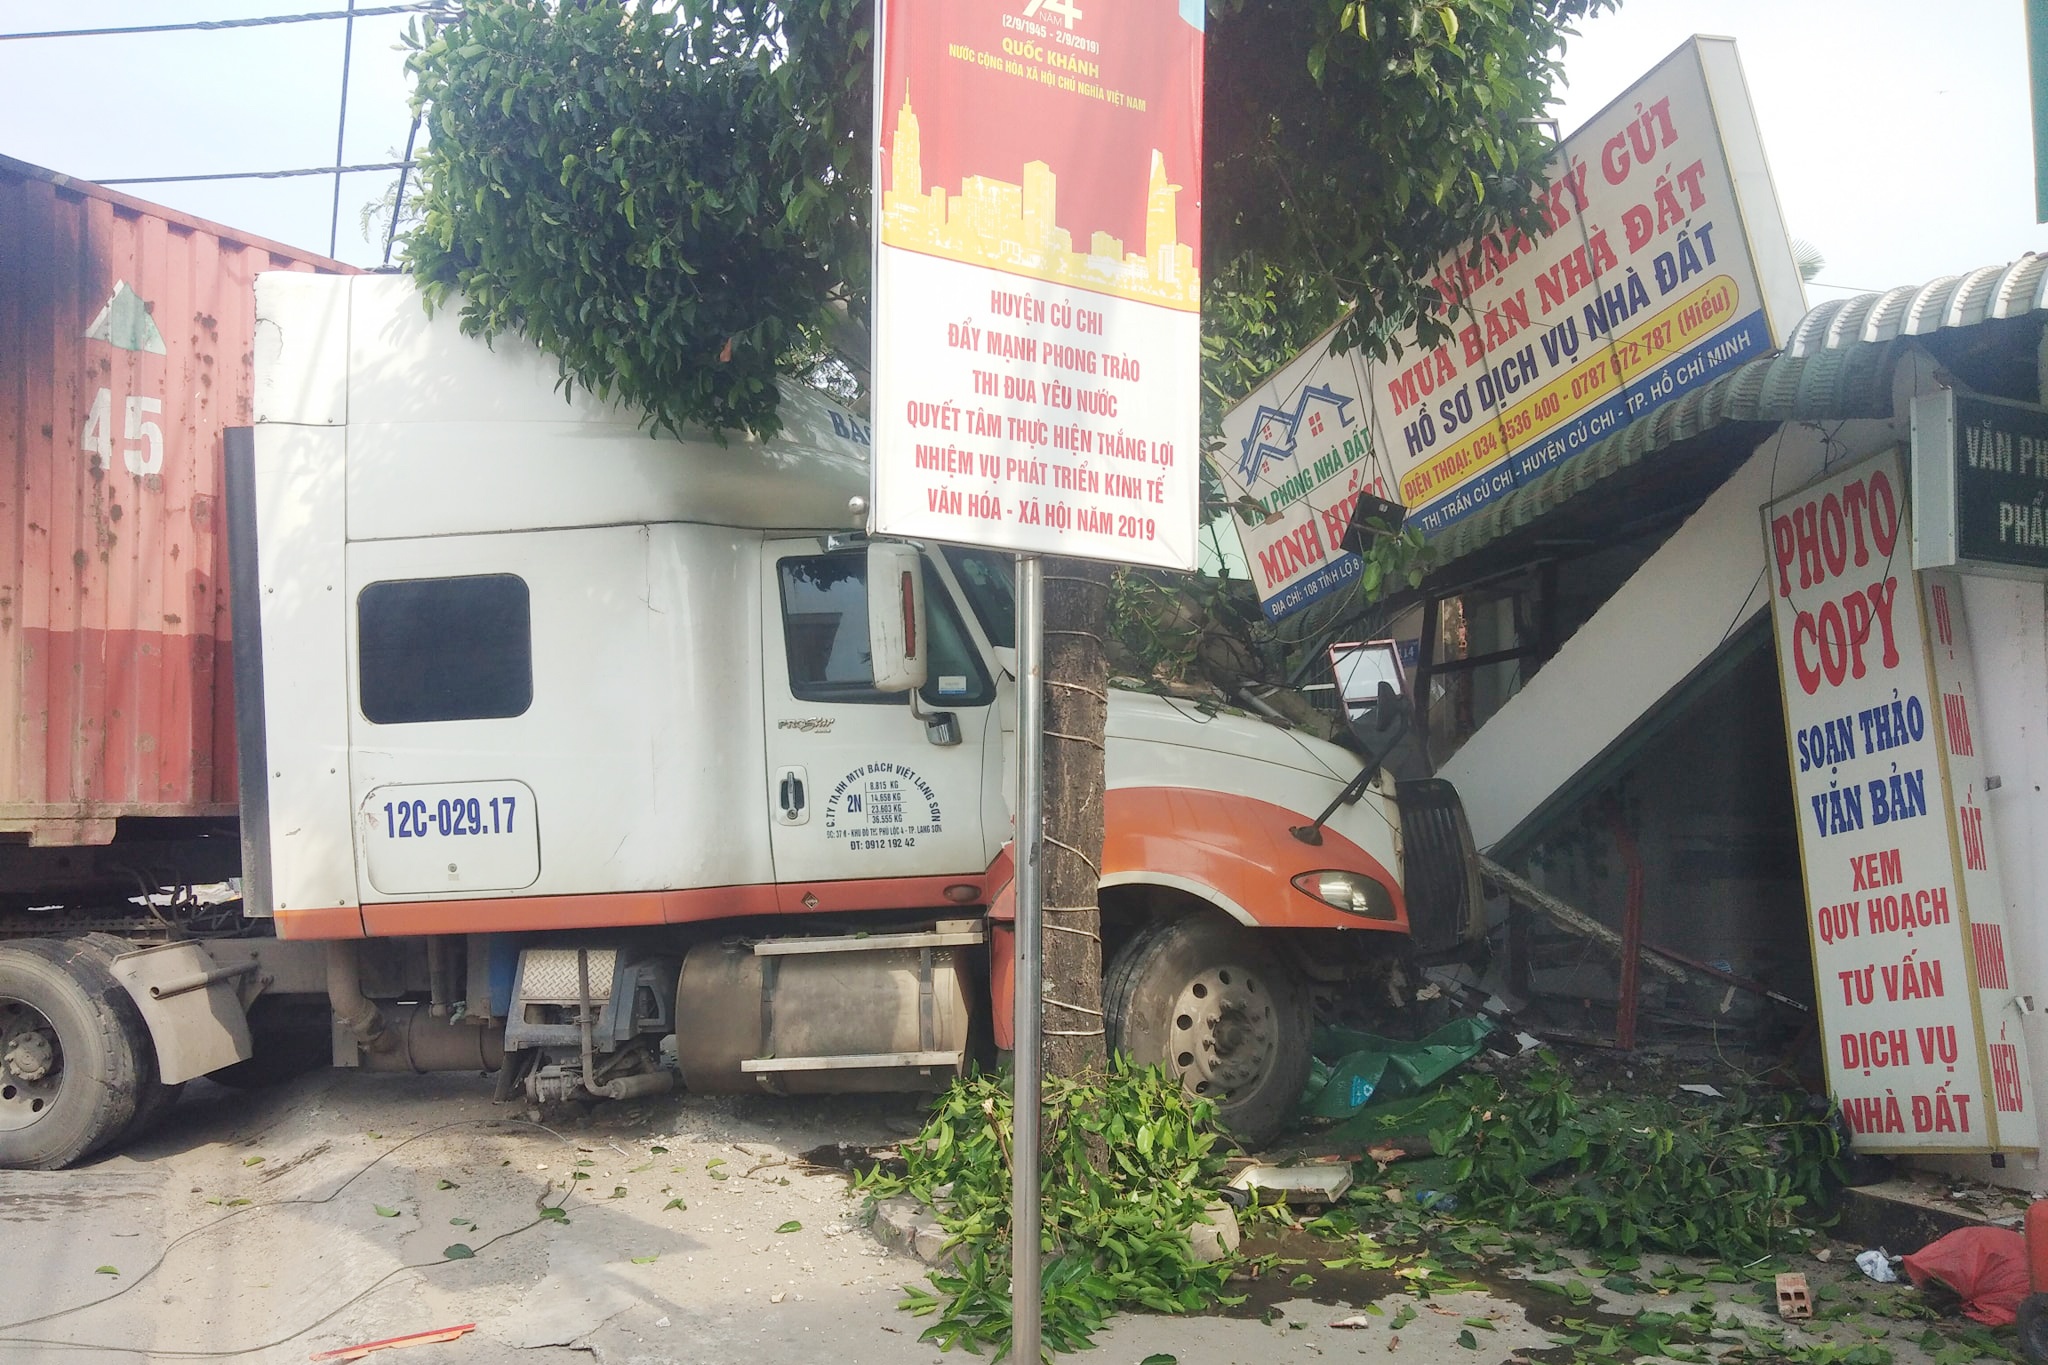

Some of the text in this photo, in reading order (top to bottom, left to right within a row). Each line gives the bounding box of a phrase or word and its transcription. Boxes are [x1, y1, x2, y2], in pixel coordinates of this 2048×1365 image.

[1002, 13, 1047, 38] (2/9/1945
[1055, 30, 1100, 55] 2/9/2019)
[1002, 36, 1099, 79] QUỐC KHÁNH
[948, 43, 975, 63] NƯỚC
[977, 51, 1003, 71] CỘNG
[1005, 59, 1023, 77] HÒA
[1040, 70, 1056, 88] HỘI
[1058, 75, 1075, 92] CHỦ
[1077, 83, 1104, 101] NGHĨA
[1106, 89, 1124, 108] VIỆT
[1126, 95, 1146, 112] NAM
[1536, 154, 1590, 239] KÝ
[1601, 95, 1679, 185] GỬI
[990, 289, 1103, 336] HUYỆN CỦ CHI
[1388, 343, 1458, 416] MUA
[1459, 288, 1531, 368] BÁN
[1535, 224, 1618, 316] NHÀ
[1621, 158, 1706, 255] ĐẤT
[948, 316, 1140, 382] ĐẨY MẠNH PHONG TRÀO
[1403, 218, 1716, 458] HỒ SƠ DỊCH VỤ NHÀ ĐẤT
[972, 369, 1118, 418] THI ĐUA YÊU NƯỚC
[1404, 470, 1432, 502] ĐIỆN
[1432, 447, 1472, 486] THOẠI:
[1472, 431, 1497, 461] 034
[1499, 409, 1532, 445] 3536
[1534, 392, 1560, 422] 400
[1571, 361, 1606, 400] 0787
[1610, 342, 1642, 376] 672
[1641, 320, 1671, 356] 787
[1677, 286, 1731, 337] (Hiếu)
[81, 387, 164, 477] 45
[906, 399, 1174, 471] QUYẾT TÂM THỰC HIỆN THẮNG LỢI
[915, 444, 1165, 505] NHIỆM VỤ PHÁT TRIỂN KINH TẾ
[1271, 467, 1314, 513] PHÒNG
[1313, 445, 1343, 486] NHÀ
[1342, 424, 1372, 463] ĐẤT
[1271, 600, 1287, 616] ĐỊA
[1286, 585, 1304, 608] CHỈ:
[1303, 580, 1318, 597] 108
[1317, 569, 1339, 590] TỈNH
[1339, 559, 1353, 578] LỘ
[1353, 558, 1360, 570] 8
[1422, 511, 1442, 530] THỊ
[1441, 491, 1472, 521] TRẤN
[1473, 477, 1491, 502] CỦ
[1492, 469, 1513, 492] CHI
[1522, 438, 1566, 476] HUYỆN
[1568, 420, 1588, 448] CỦ
[1590, 409, 1616, 435] CHI
[1625, 392, 1648, 415] TP.
[1650, 369, 1674, 403] HỒ
[1676, 351, 1706, 385] CHÍ
[1707, 330, 1751, 364] MINH
[927, 485, 962, 516] VĂN
[968, 490, 1001, 521] HÓA
[1018, 497, 1040, 526] XÃ
[1045, 500, 1072, 534] HỘI
[1077, 507, 1113, 536] NĂM
[1118, 514, 1155, 541] 2019
[1772, 470, 1897, 598] PHOTO
[1258, 519, 1325, 589] MINH
[1793, 576, 1900, 695] COPY
[1797, 688, 1924, 774] SOẠN THẢO
[1943, 681, 1974, 757] NHÀ
[846, 767, 865, 783] MTV
[867, 761, 893, 774] BÁCH
[895, 765, 916, 780] VIỆT
[914, 776, 935, 801] LẠNG
[929, 801, 941, 823] SƠN
[847, 794, 862, 813] 2N
[870, 780, 899, 790] 8.815 KG
[892, 792, 902, 801] KG
[894, 804, 902, 813] KG
[1811, 762, 1927, 838] VĂN BẢN
[383, 796, 516, 839] 12C-029.17
[850, 840, 863, 850] ĐT:
[888, 838, 902, 848] 192
[905, 837, 915, 847] 42
[894, 814, 903, 823] KG
[1850, 848, 1903, 892] XEM
[1818, 887, 1950, 945] QUY HOẠCH
[1838, 948, 1944, 1006] TƯ VẤN
[1971, 922, 2009, 990] MINH
[1840, 1025, 1958, 1077] DỊCH VỤ
[1989, 1020, 2024, 1113] HIẾU
[1842, 1080, 1970, 1134] NHÀ ĐẤT
